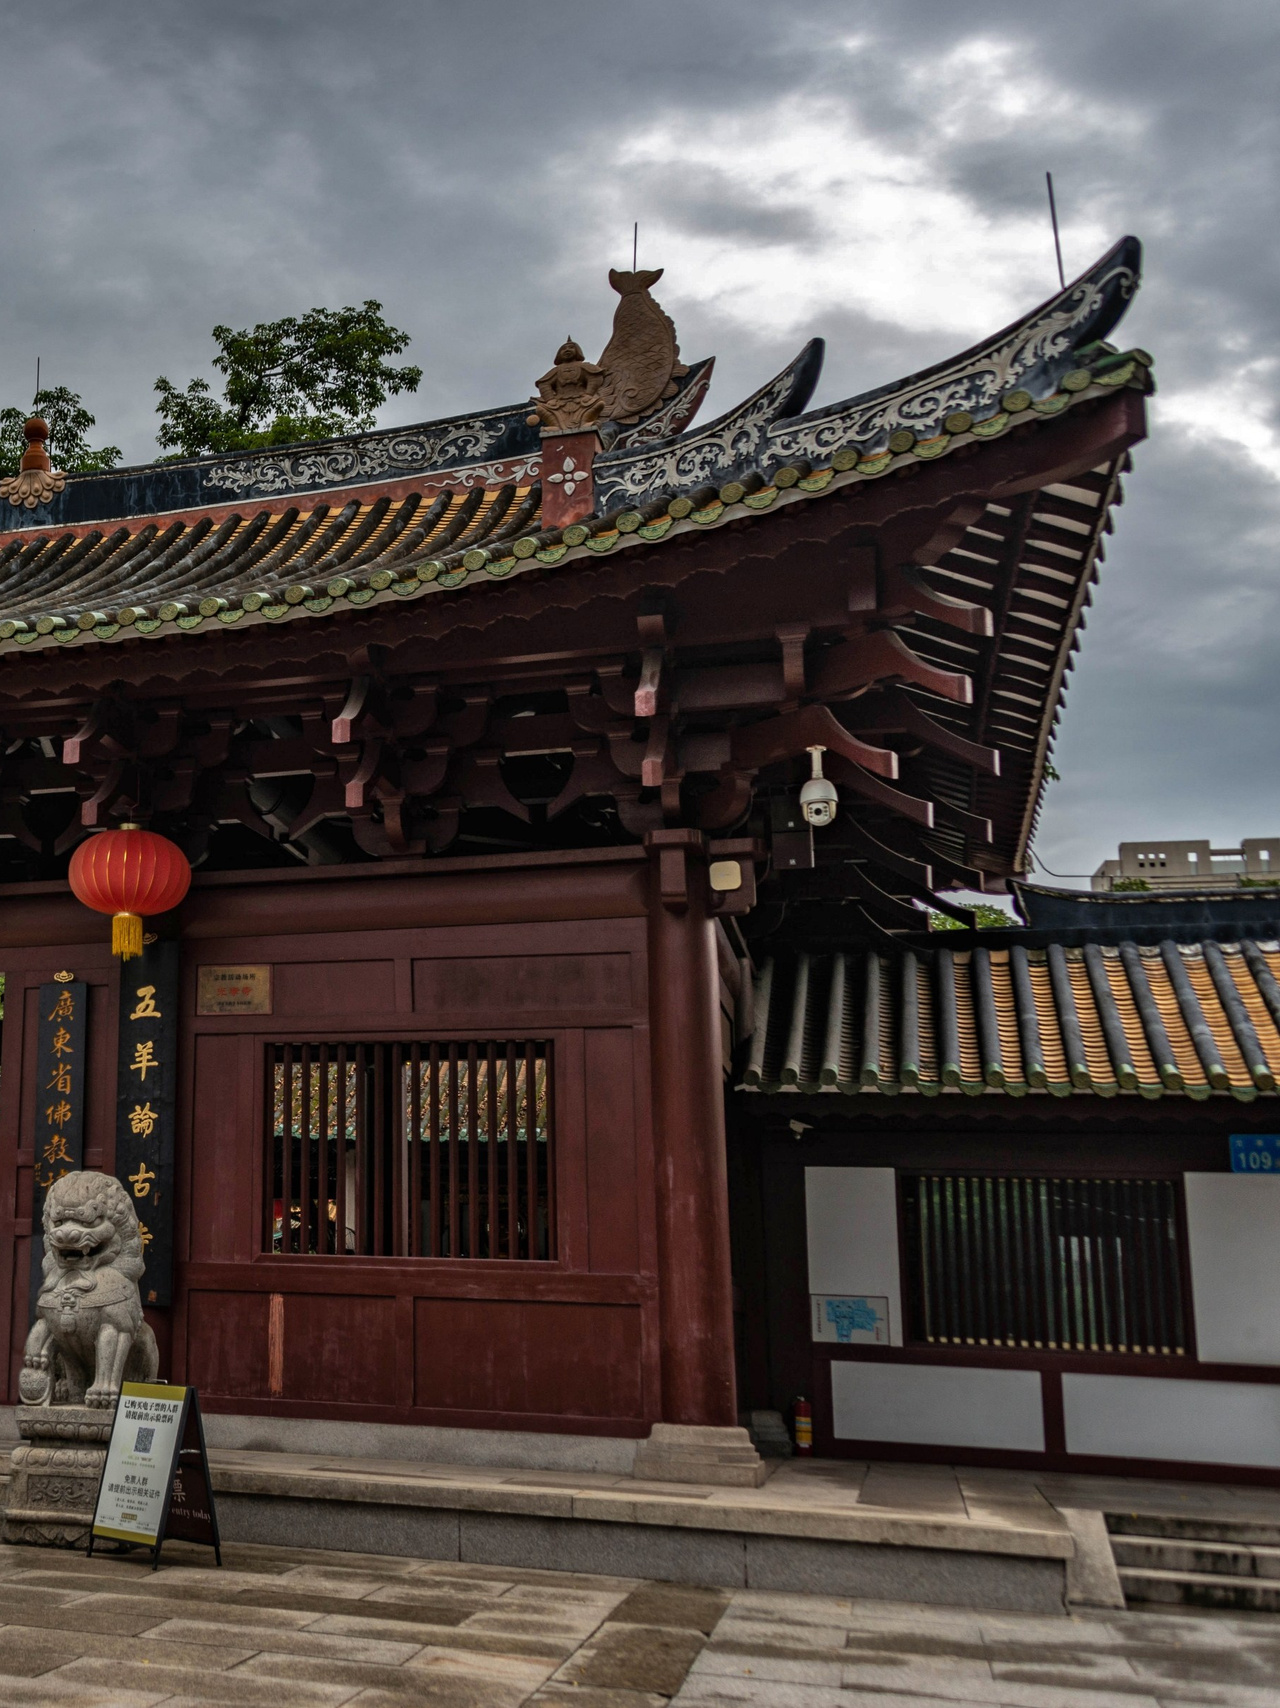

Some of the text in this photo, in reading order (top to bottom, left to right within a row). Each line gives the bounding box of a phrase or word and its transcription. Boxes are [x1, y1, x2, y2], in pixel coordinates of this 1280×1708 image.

[40, 990, 75, 1190] 廣東省佛教
[123, 1399, 179, 1414] 已购买电子票的人群
[123, 1474, 149, 1487] 免票人群
[107, 1483, 161, 1500] 请提前出示相关证件
[171, 1507, 211, 1523] entry today
